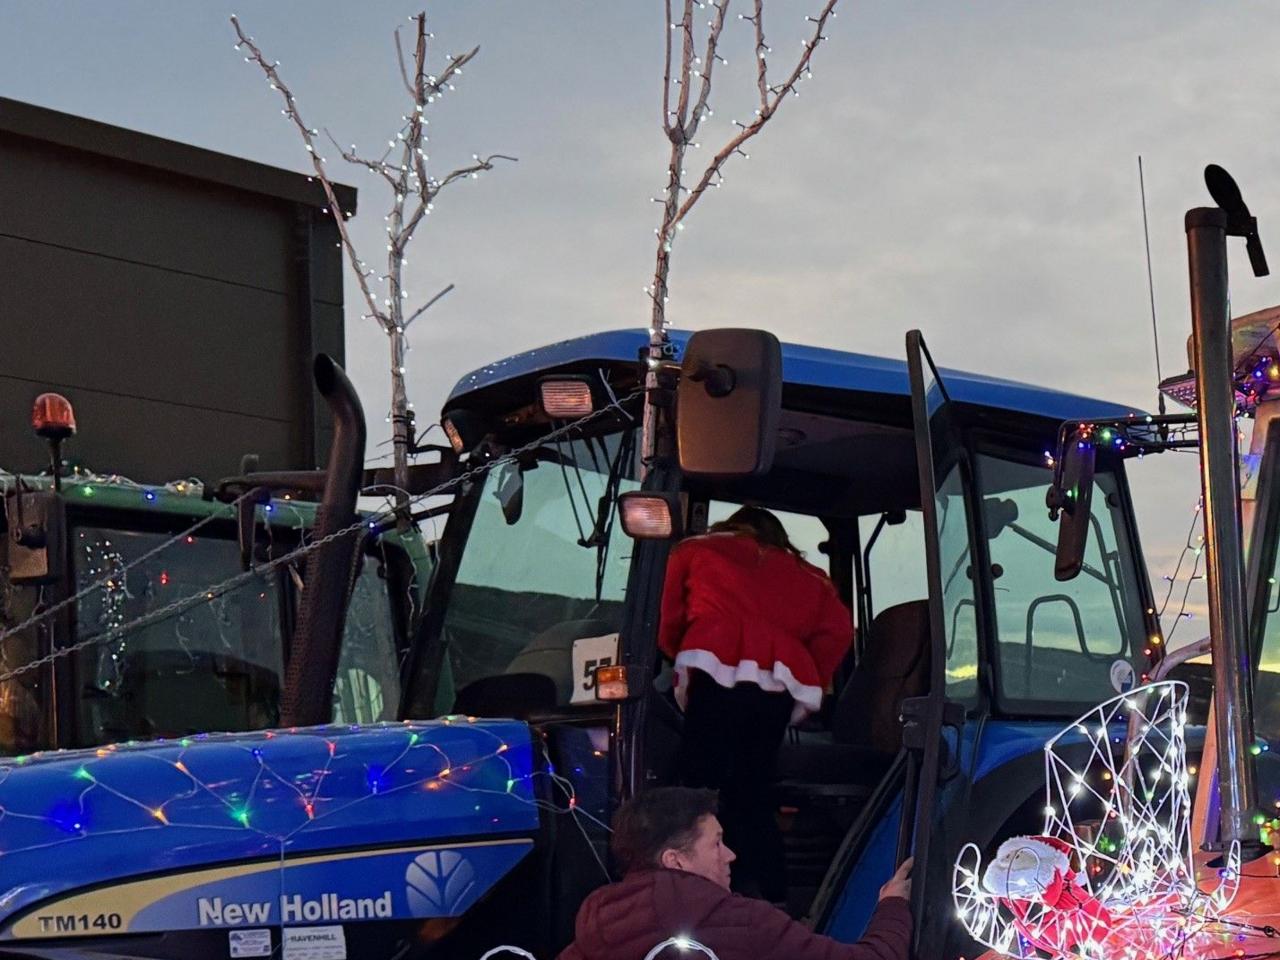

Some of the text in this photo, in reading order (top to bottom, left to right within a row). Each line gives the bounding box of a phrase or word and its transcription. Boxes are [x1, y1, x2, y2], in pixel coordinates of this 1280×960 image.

[38, 912, 123, 932] TM140
[198, 891, 393, 926] New Holland
